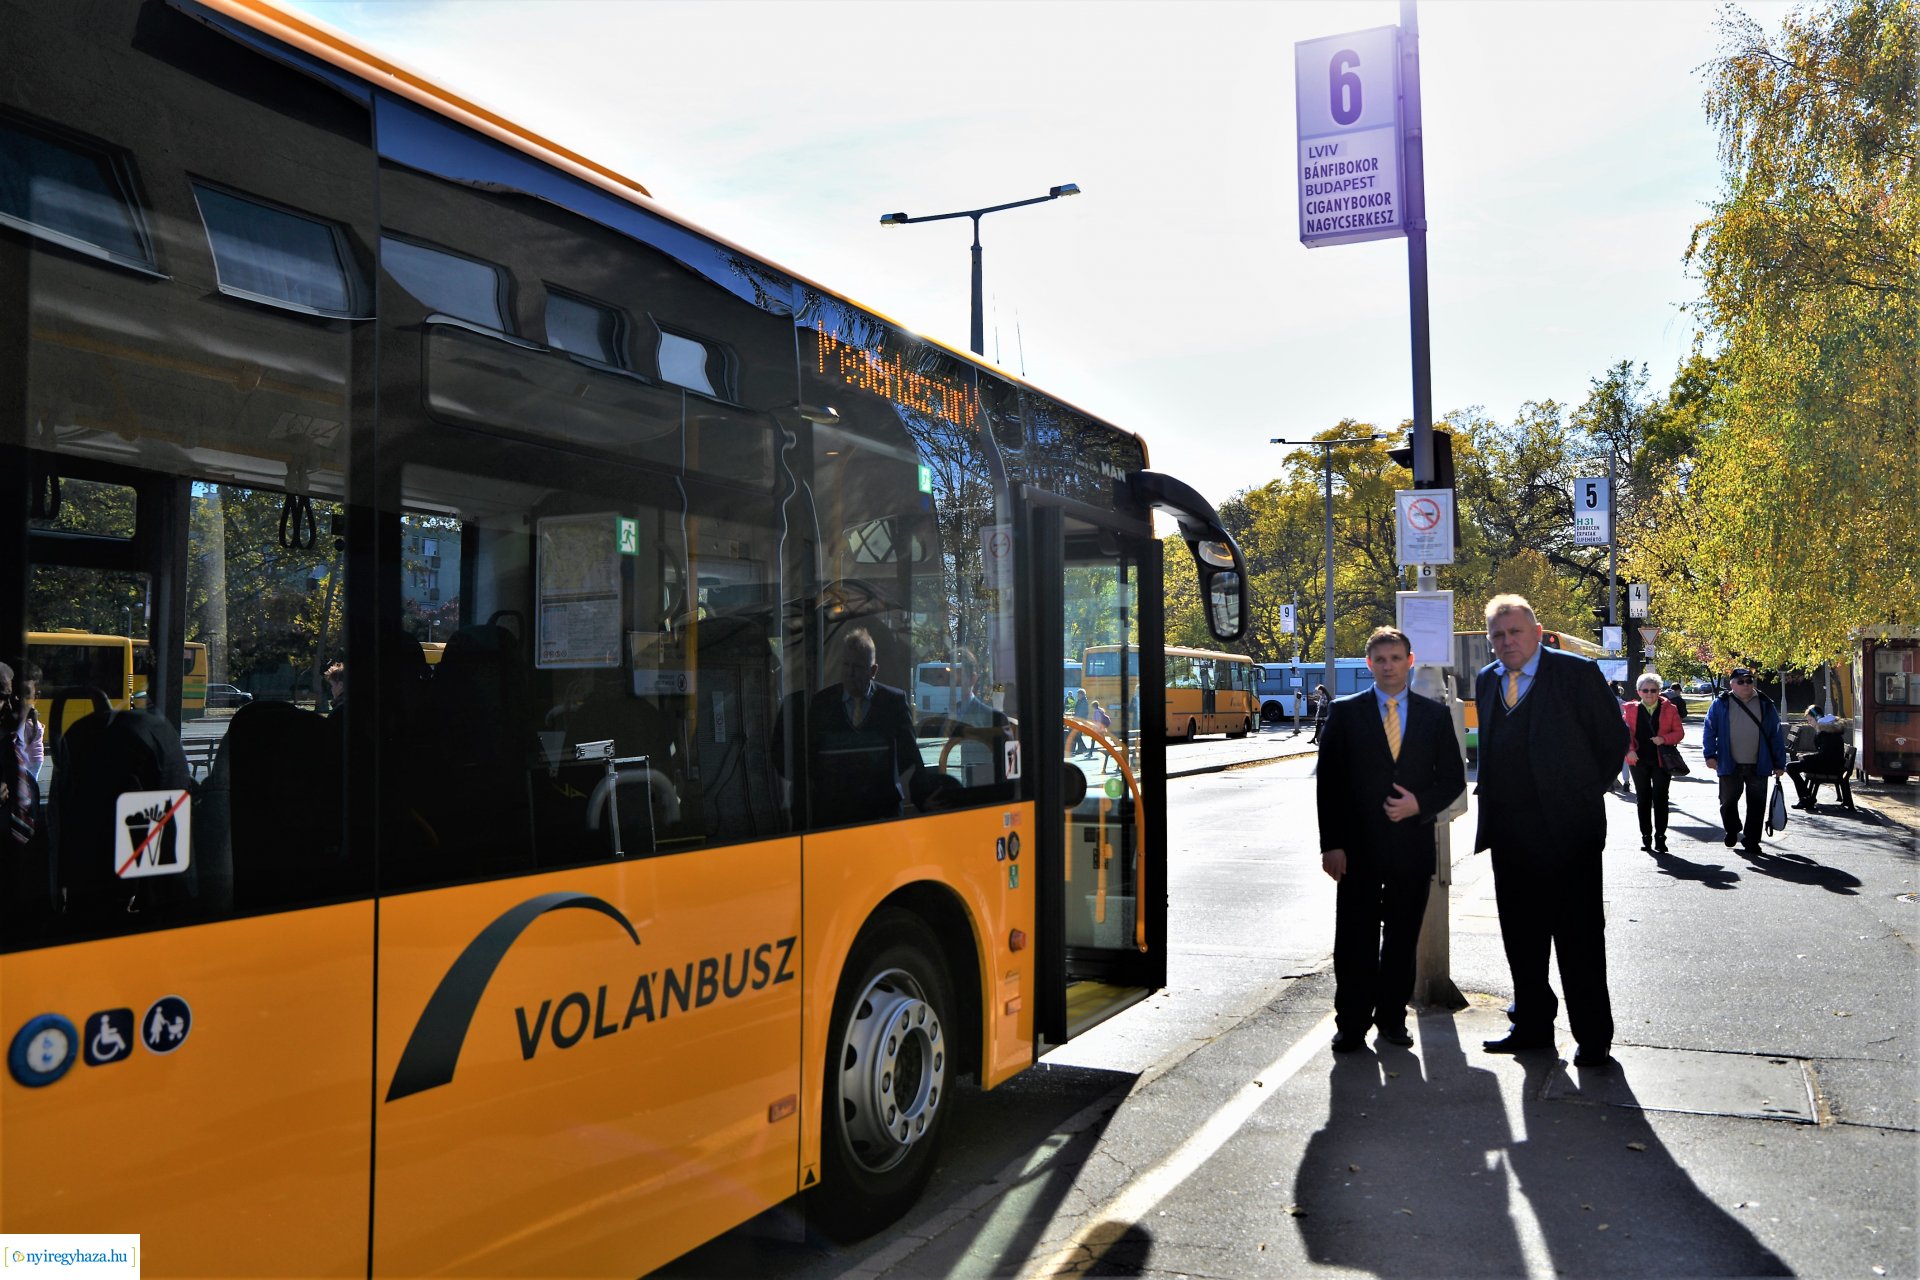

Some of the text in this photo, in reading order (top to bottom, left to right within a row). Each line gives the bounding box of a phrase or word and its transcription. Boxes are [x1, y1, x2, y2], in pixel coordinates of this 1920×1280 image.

[1329, 49, 1363, 126] 6
[1308, 143, 1339, 159] LVIV
[1304, 157, 1379, 180] BÁNFIBOKOR
[1305, 175, 1376, 197] BUDAPEST
[1306, 210, 1394, 233] NAGYCSERKESZ
[1100, 460, 1127, 483] MAN
[1586, 483, 1598, 509] 5
[1422, 566, 1432, 577] 6
[1635, 586, 1642, 600] 4
[1284, 606, 1290, 618] 9
[514, 935, 798, 1061] VOLÁNBUSZ
